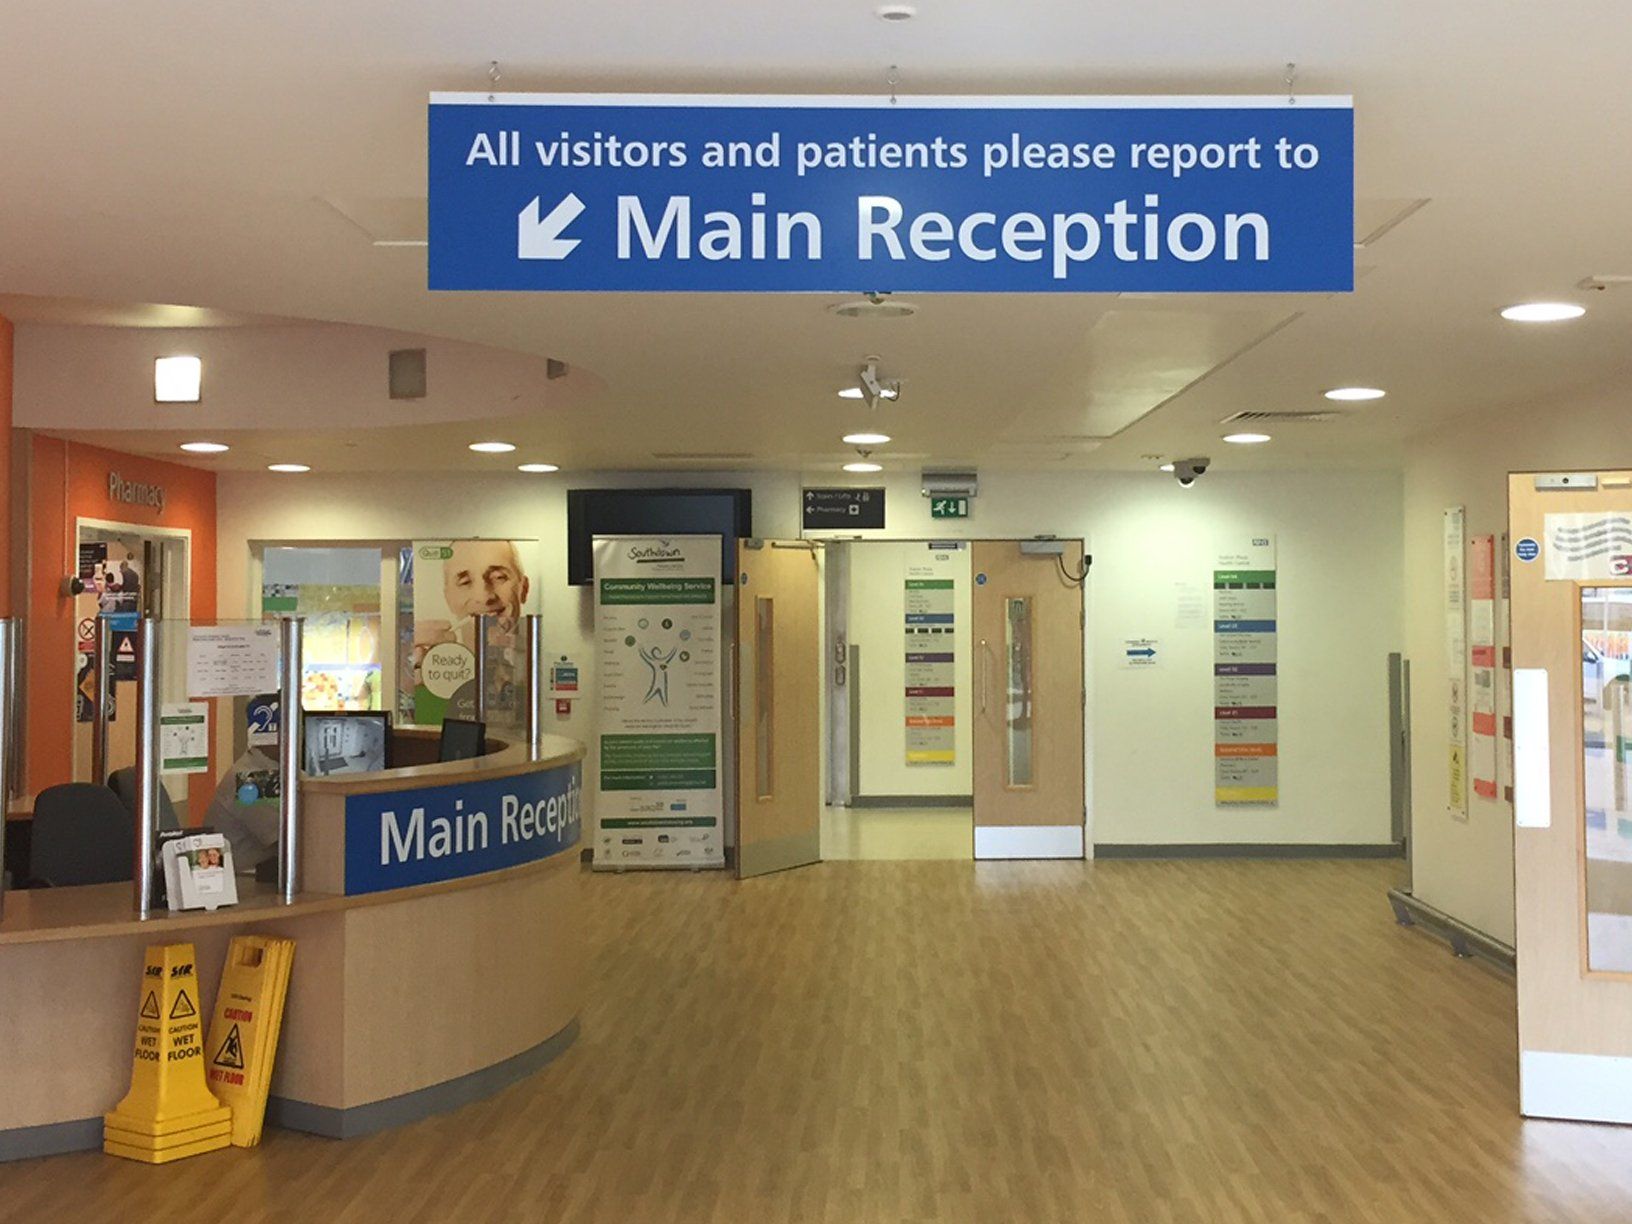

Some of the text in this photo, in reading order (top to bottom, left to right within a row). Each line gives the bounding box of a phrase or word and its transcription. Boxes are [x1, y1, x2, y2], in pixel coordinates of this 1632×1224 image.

[466, 131, 1320, 177] All visitors and patients please report to
[617, 192, 1270, 279] Main Reception
[109, 471, 167, 517] Pharmacy
[628, 547, 681, 560] Southdown
[604, 582, 711, 592] Community Wellbeing Service
[432, 654, 467, 668] Ready
[428, 668, 471, 681] to quit?
[381, 799, 488, 866] Main
[171, 963, 193, 978] SIR
[225, 1007, 253, 1023] CAUTION
[168, 1023, 199, 1035] CAUTION
[141, 1037, 157, 1047] WET
[172, 1034, 195, 1047] WET
[135, 1048, 160, 1062] FLOOR
[167, 1046, 201, 1062] FLOOR
